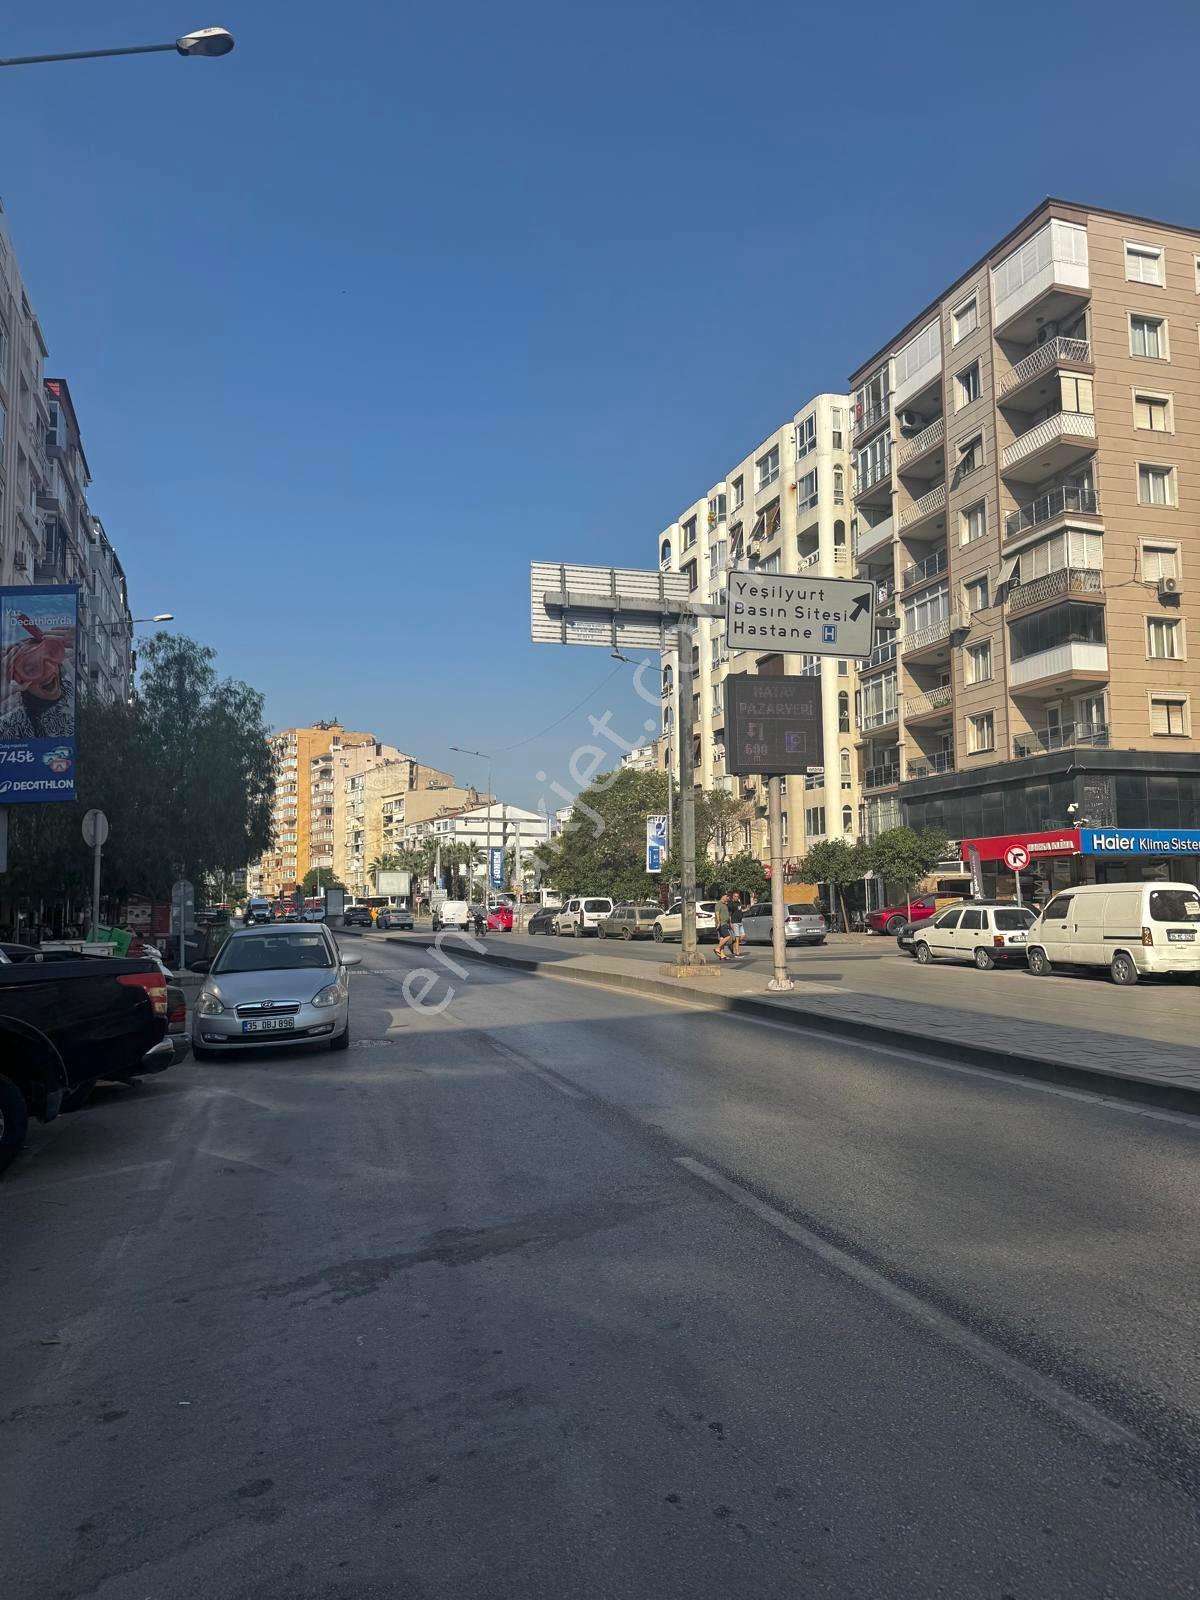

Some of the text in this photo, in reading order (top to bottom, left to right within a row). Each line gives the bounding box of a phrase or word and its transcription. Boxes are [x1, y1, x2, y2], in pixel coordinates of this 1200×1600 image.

[736, 582, 825, 602] Yeşilyurt
[734, 602, 848, 622] Basın Sitesi
[734, 621, 813, 639] Hastane
[13, 779, 74, 791] DECATHLON
[1092, 833, 1135, 850] Haier
[1139, 837, 1170, 850] Klima
[247, 1021, 257, 1030] 35
[278, 1019, 293, 1028] 896
